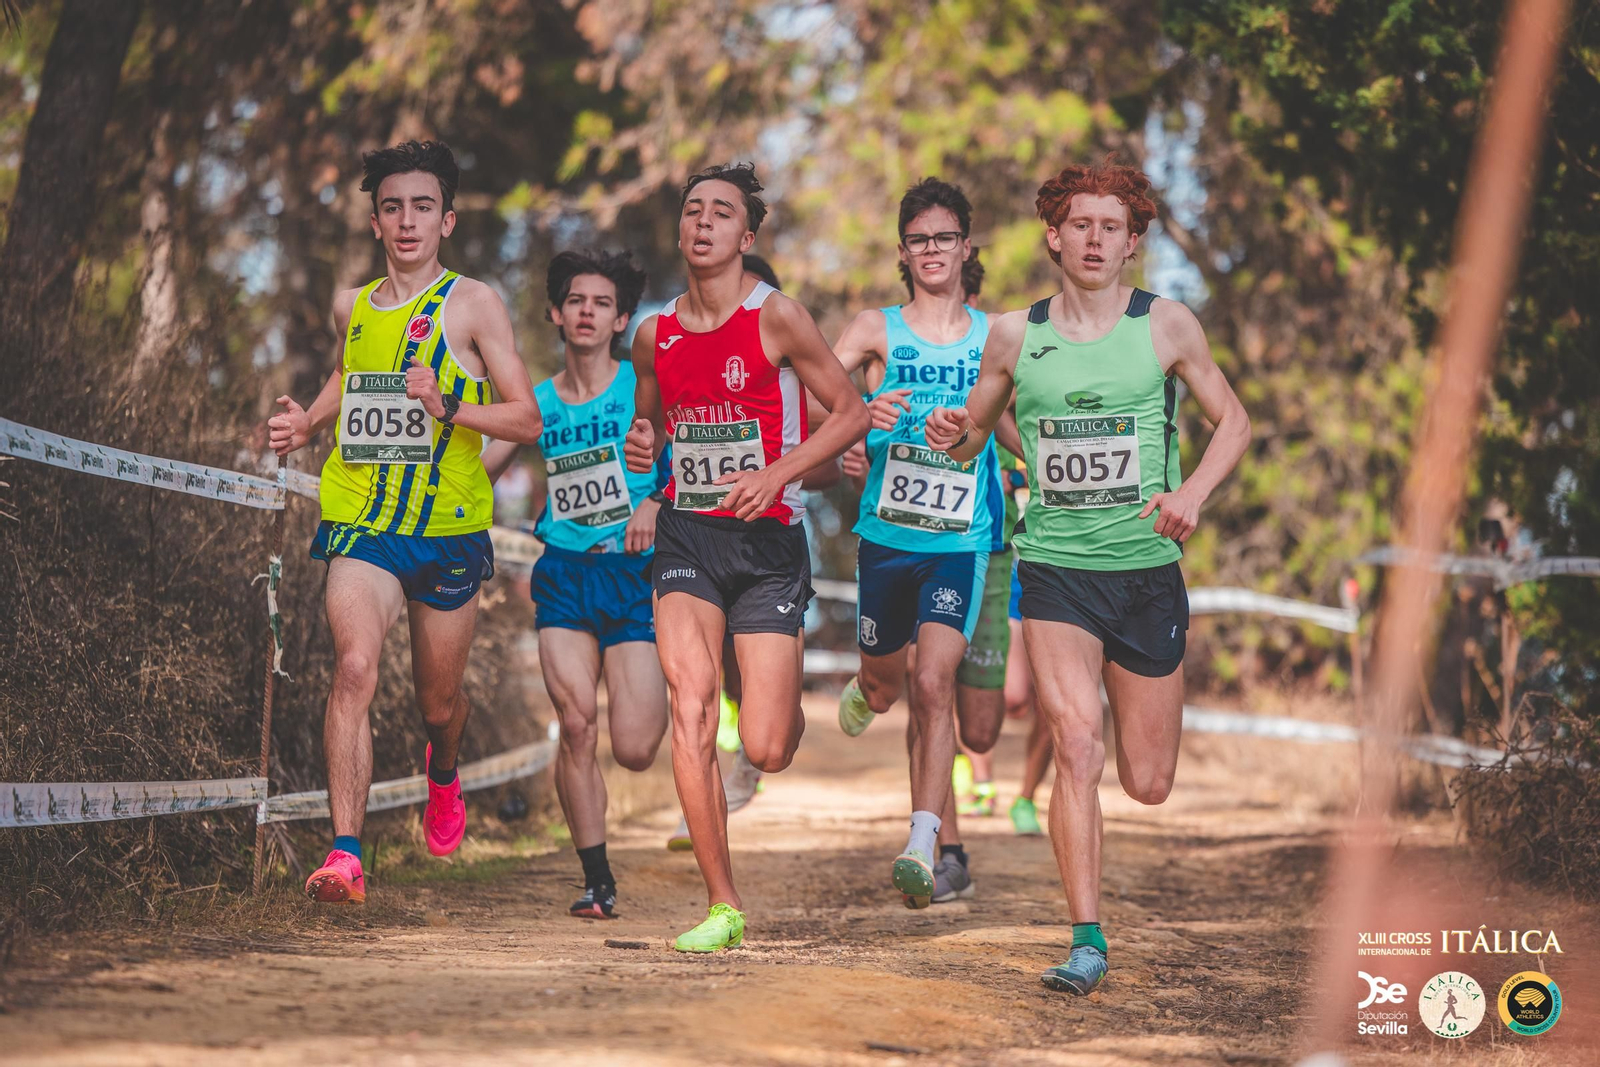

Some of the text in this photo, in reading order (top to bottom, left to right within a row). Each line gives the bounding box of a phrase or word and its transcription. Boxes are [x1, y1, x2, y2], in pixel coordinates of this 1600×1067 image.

[365, 374, 407, 387] ITÁLICA
[895, 359, 980, 392] nerja
[347, 407, 426, 438] 6058
[543, 415, 621, 450] nerja
[692, 425, 734, 438] ITÁLICA
[1061, 419, 1110, 433] ITÁLICA
[560, 452, 596, 469] ITÁLICA
[680, 453, 760, 486] 8166
[1045, 449, 1131, 483] 6057
[555, 475, 622, 513] 8204
[890, 475, 969, 512] 8217
